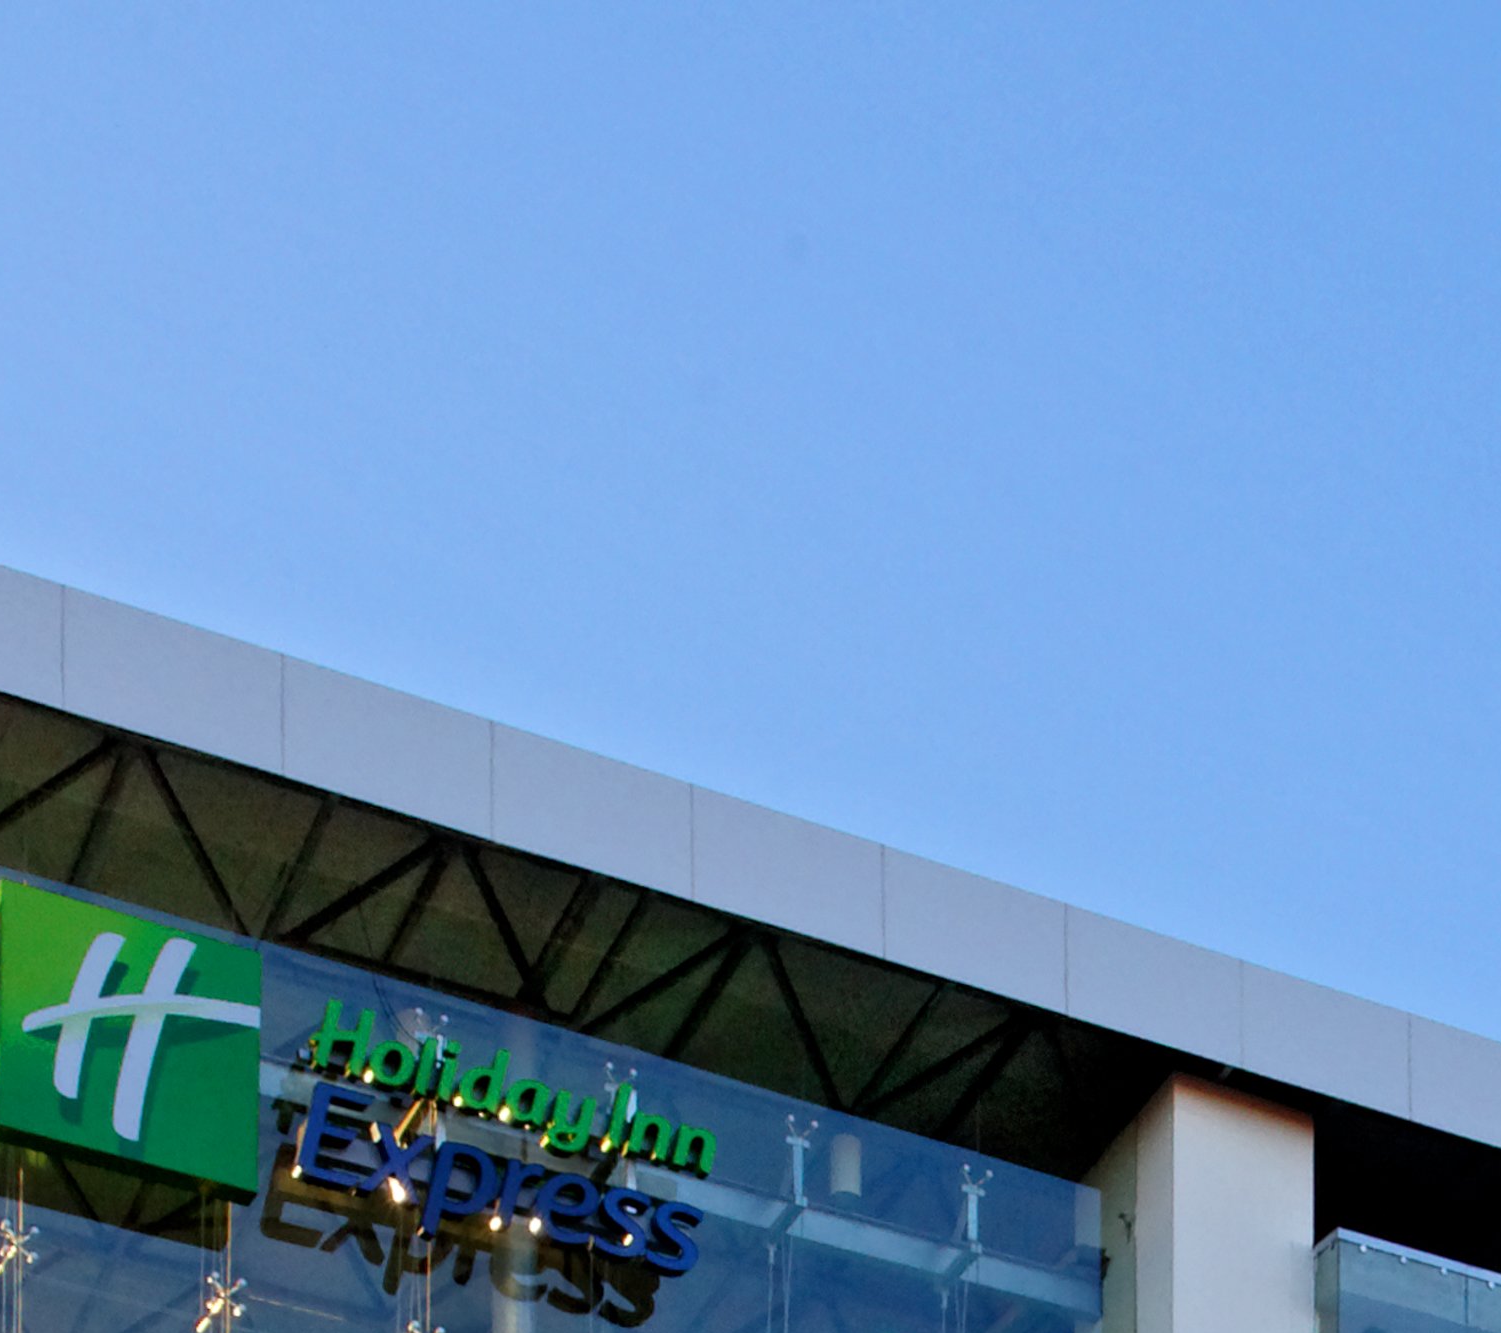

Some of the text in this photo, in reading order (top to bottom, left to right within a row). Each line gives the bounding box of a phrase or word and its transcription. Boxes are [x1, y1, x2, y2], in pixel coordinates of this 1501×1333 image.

[296, 1081, 704, 1277] Express
[309, 998, 717, 1178] Holiday Inn
